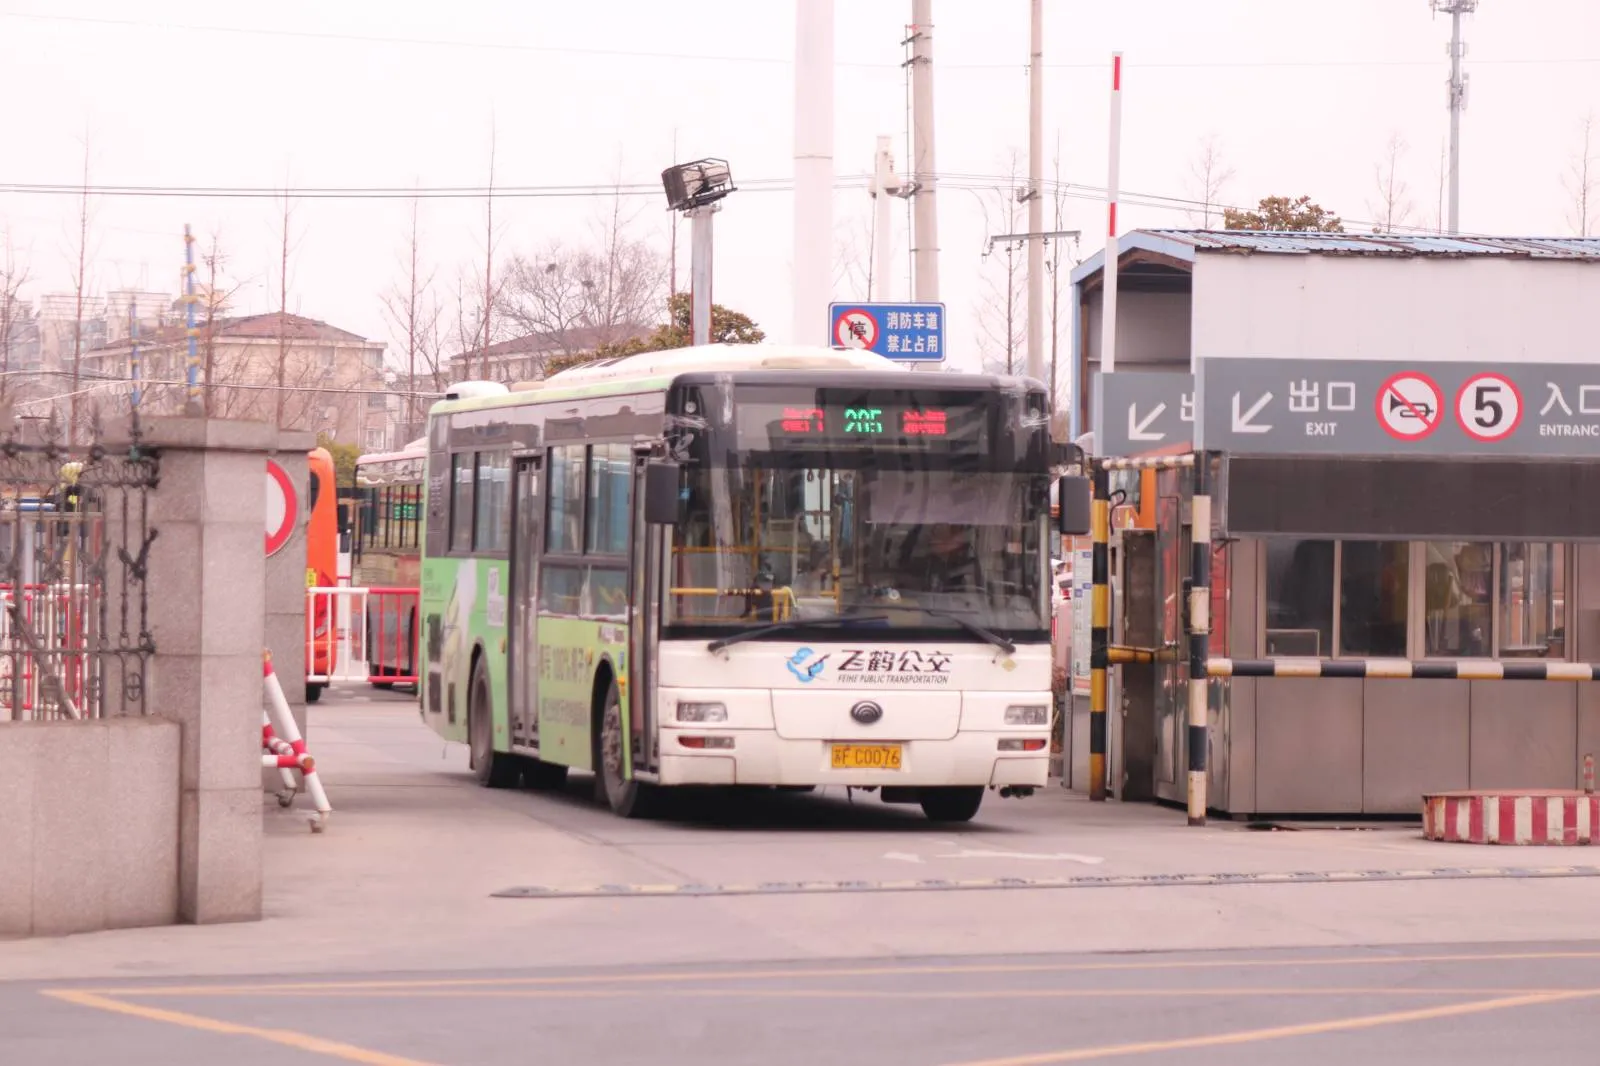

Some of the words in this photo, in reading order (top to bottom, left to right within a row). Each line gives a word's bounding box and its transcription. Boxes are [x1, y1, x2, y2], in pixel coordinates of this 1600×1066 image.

[848, 320, 867, 340] 停
[886, 311, 939, 330] 消防车道
[886, 335, 939, 353] 禁止占用
[1288, 379, 1356, 412] 出口
[1540, 382, 1600, 417] 入口
[1474, 386, 1504, 428] 5
[1305, 422, 1338, 436] EXIT
[837, 649, 954, 673] 飞鹤公交
[837, 674, 858, 683] FEIHE
[859, 674, 885, 684] PUBLIC
[886, 674, 949, 684] TRANSPORTATION
